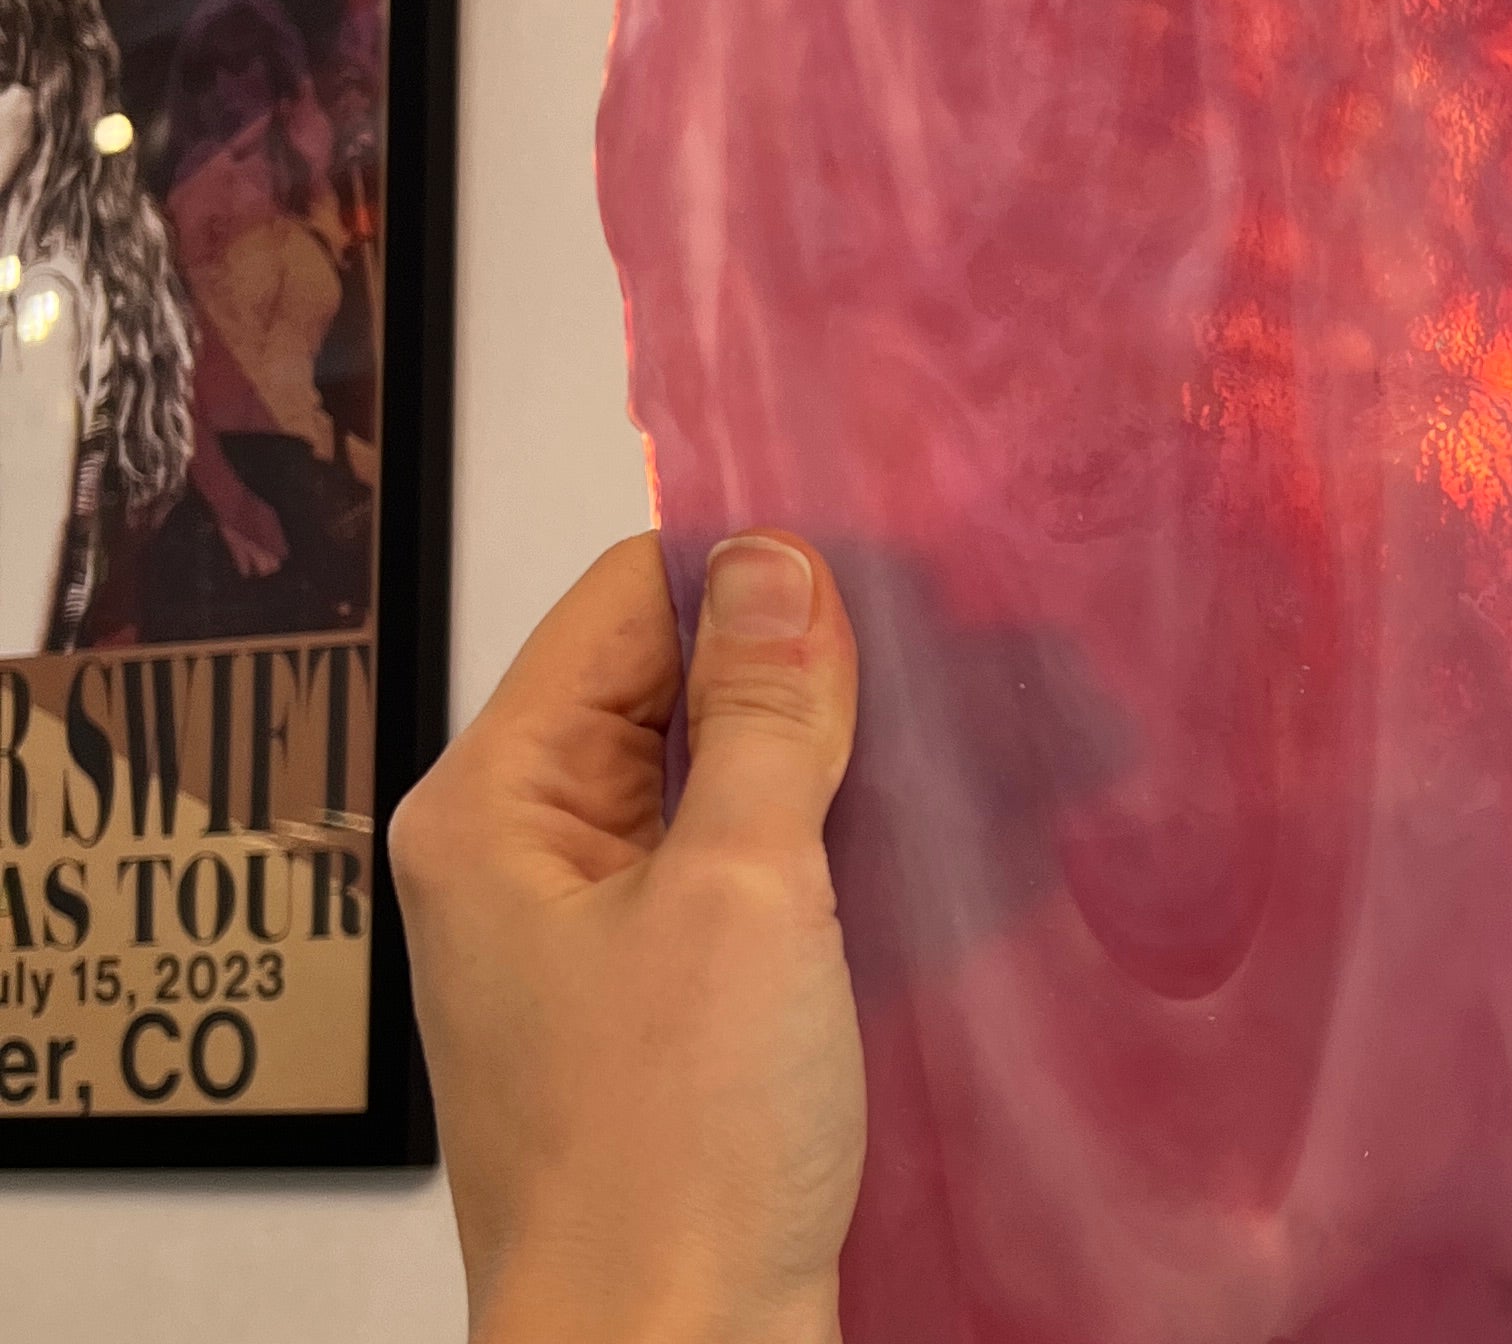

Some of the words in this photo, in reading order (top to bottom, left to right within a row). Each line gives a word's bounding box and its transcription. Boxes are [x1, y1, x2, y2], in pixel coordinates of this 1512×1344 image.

[63, 643, 373, 849] SWIFT
[117, 846, 369, 945] TOUR
[73, 955, 137, 1013] 15,
[154, 951, 285, 1002] 2023
[0, 1035, 92, 1117] er,
[119, 1009, 258, 1101] CO
